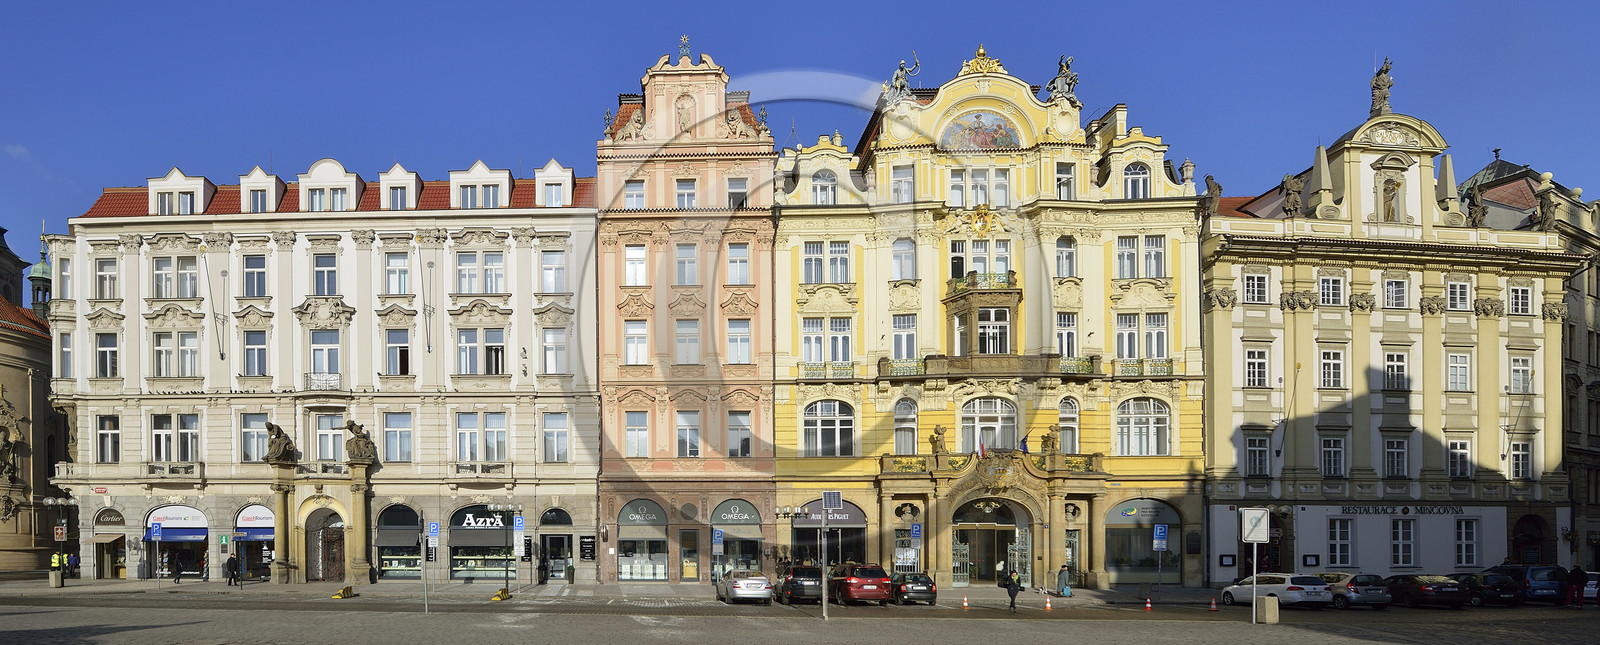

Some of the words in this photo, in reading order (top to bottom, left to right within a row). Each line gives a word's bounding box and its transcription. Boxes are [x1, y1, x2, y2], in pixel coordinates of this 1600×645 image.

[1341, 506, 1397, 515] RESTAURACE
[1414, 506, 1464, 515] MINCOVNA
[100, 514, 122, 522] Cartier
